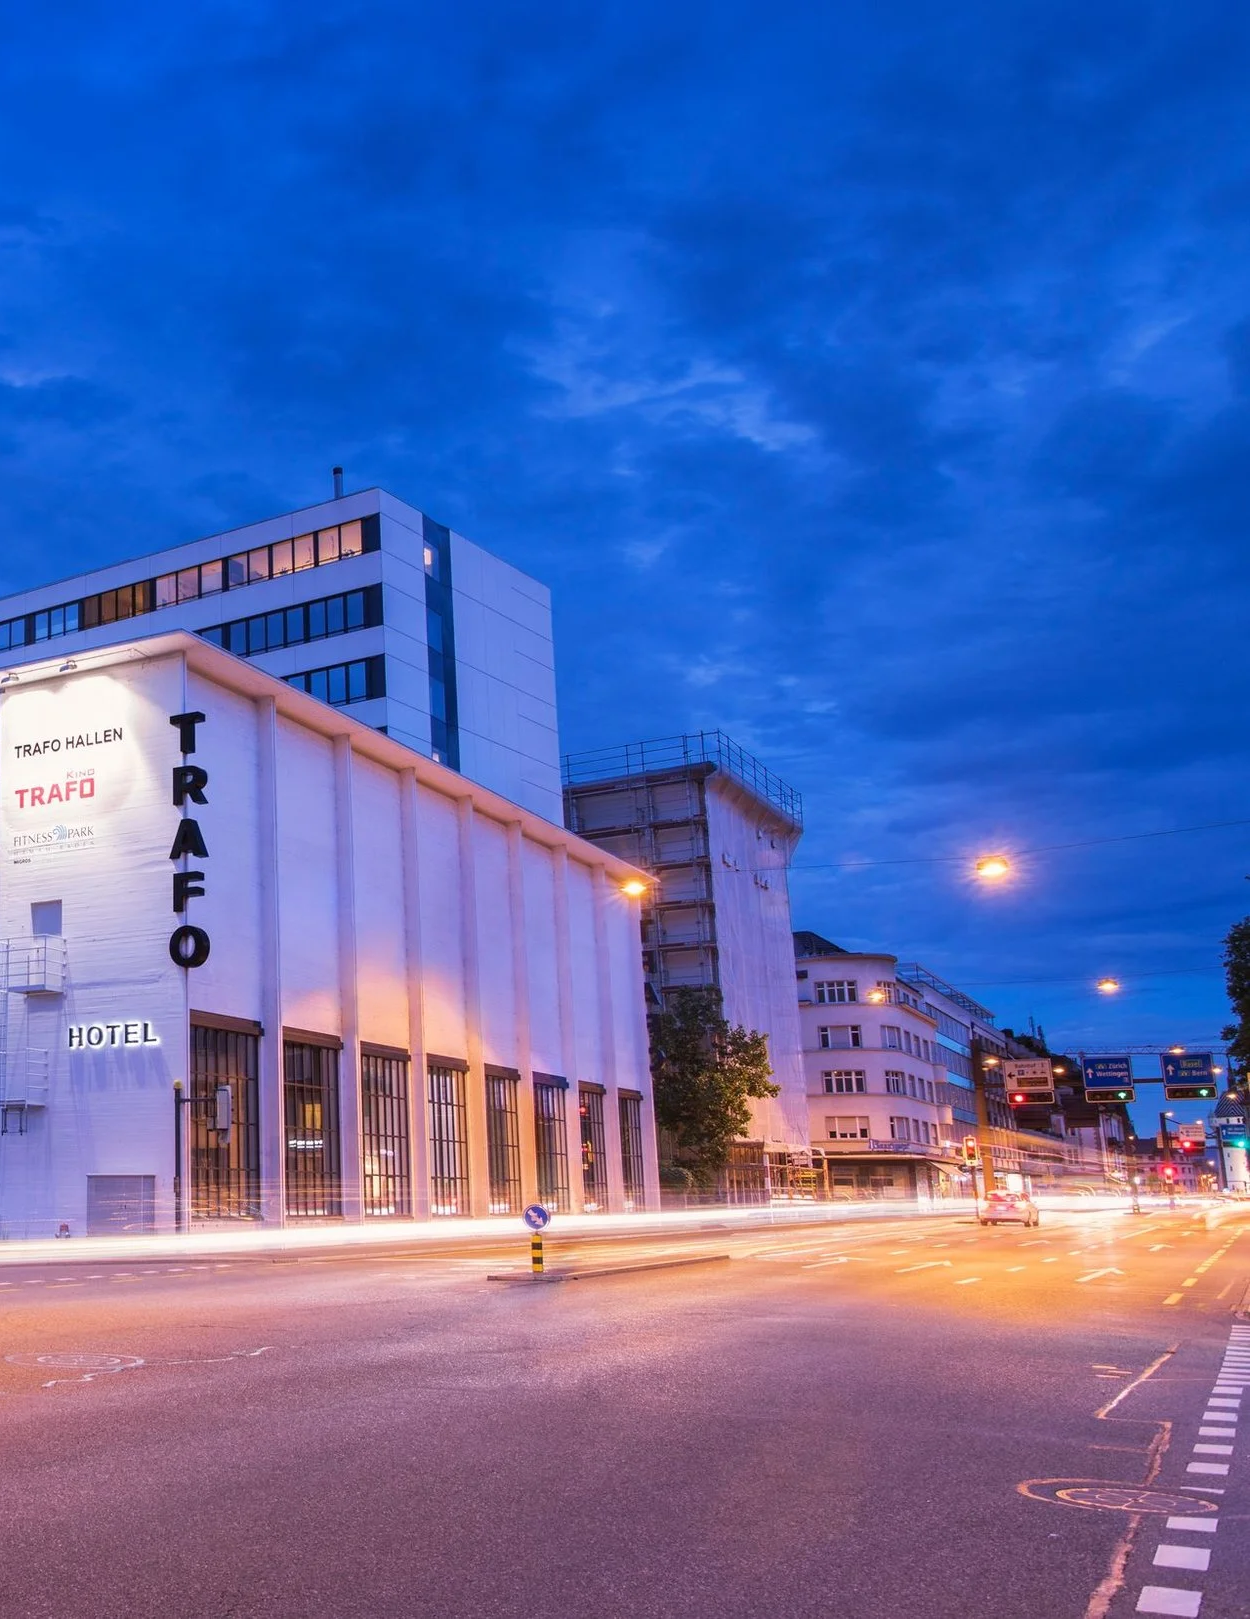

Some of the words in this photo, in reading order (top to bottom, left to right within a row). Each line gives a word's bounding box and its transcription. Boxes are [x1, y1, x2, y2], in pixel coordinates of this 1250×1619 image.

[14, 738, 61, 759] TRAFO
[66, 727, 123, 750] HALLEN
[14, 777, 95, 809] TRAFO
[13, 831, 53, 847] FITNESS
[67, 826, 94, 839] PARK
[169, 711, 210, 968] TRAFO
[68, 1022, 158, 1048] HOTEL
